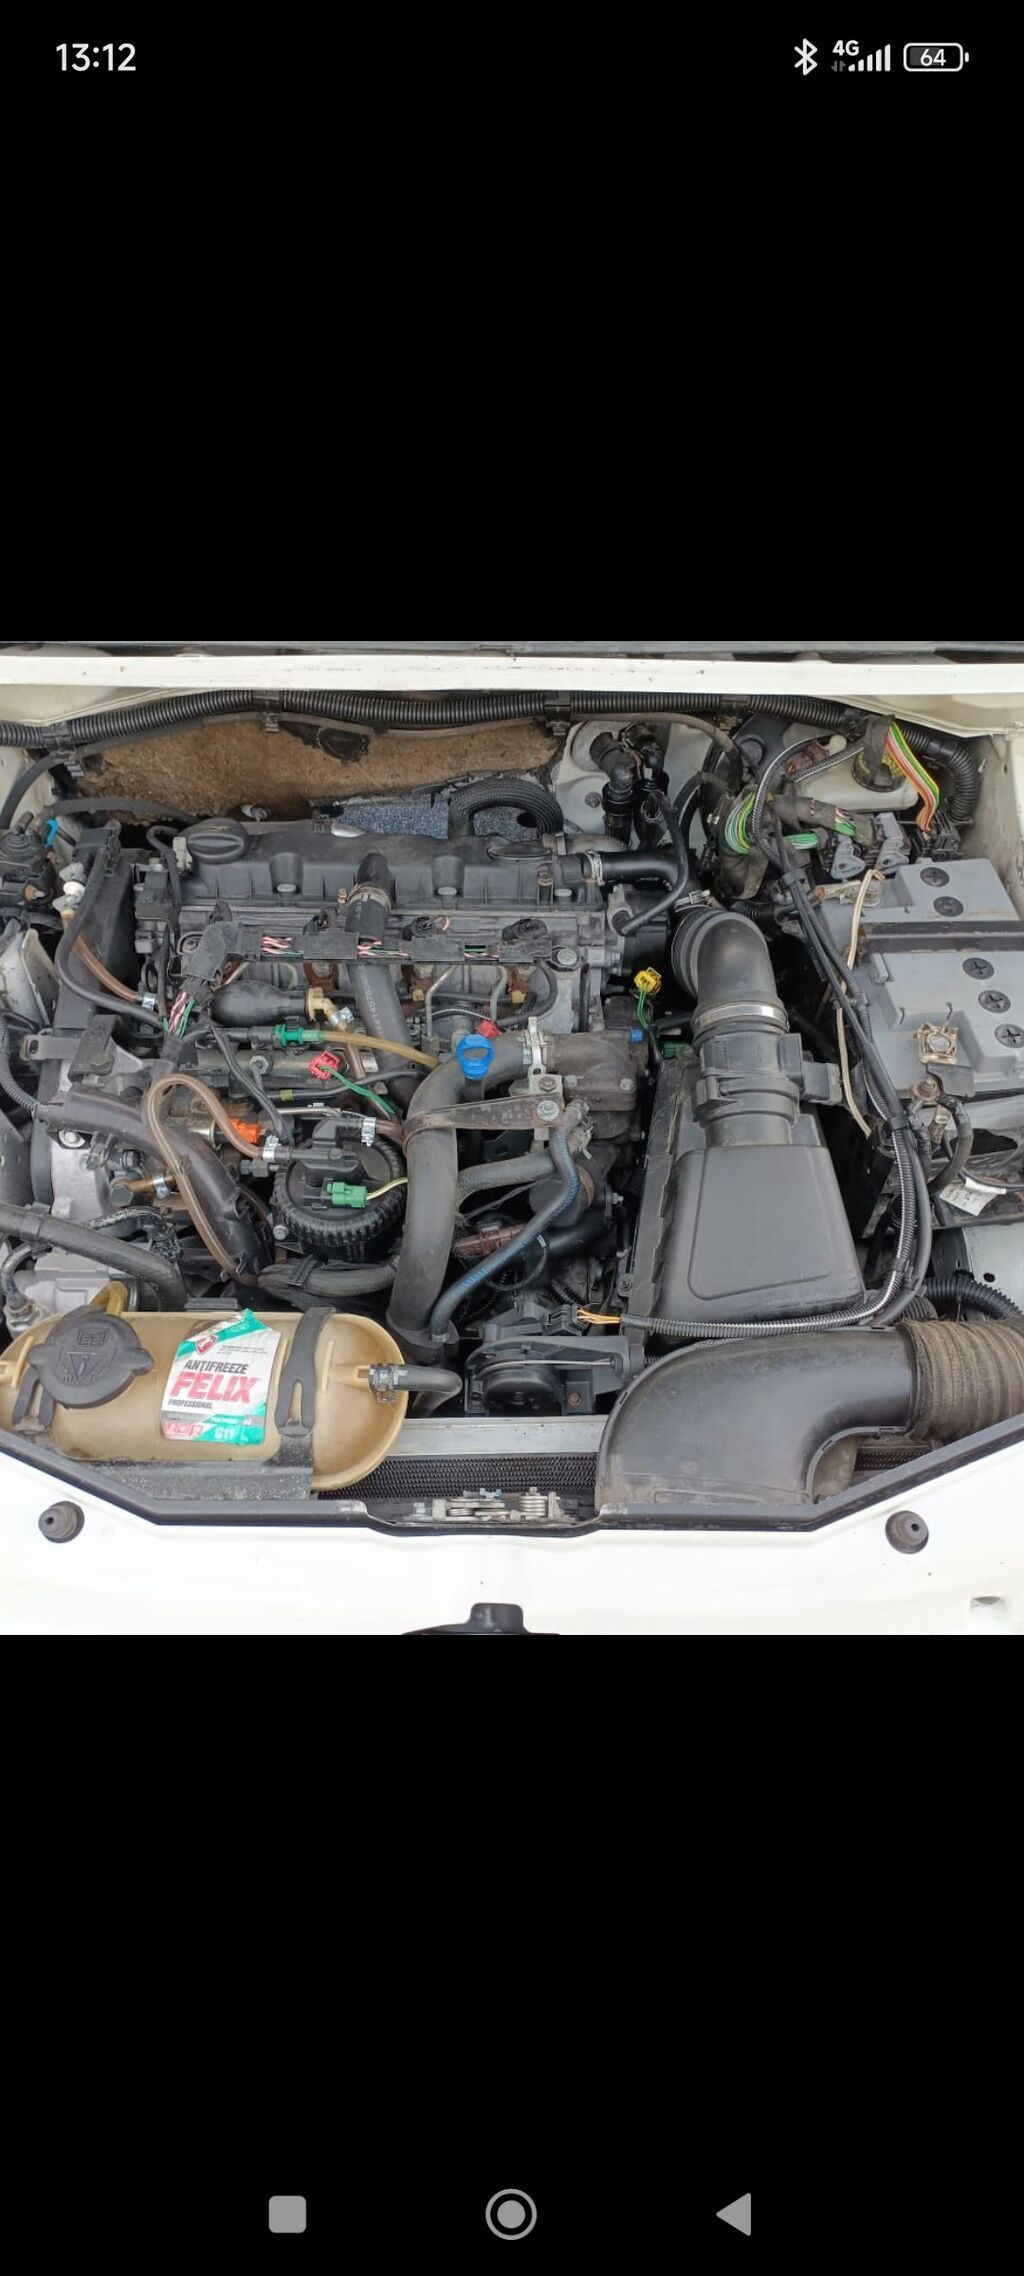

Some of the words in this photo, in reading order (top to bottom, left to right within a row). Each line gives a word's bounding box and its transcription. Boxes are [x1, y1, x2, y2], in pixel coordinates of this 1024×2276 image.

[184, 1360, 250, 1375] ANTIFREEZE
[169, 1371, 261, 1404] FELIX
[167, 1398, 213, 1410] PROFESSIONAL
